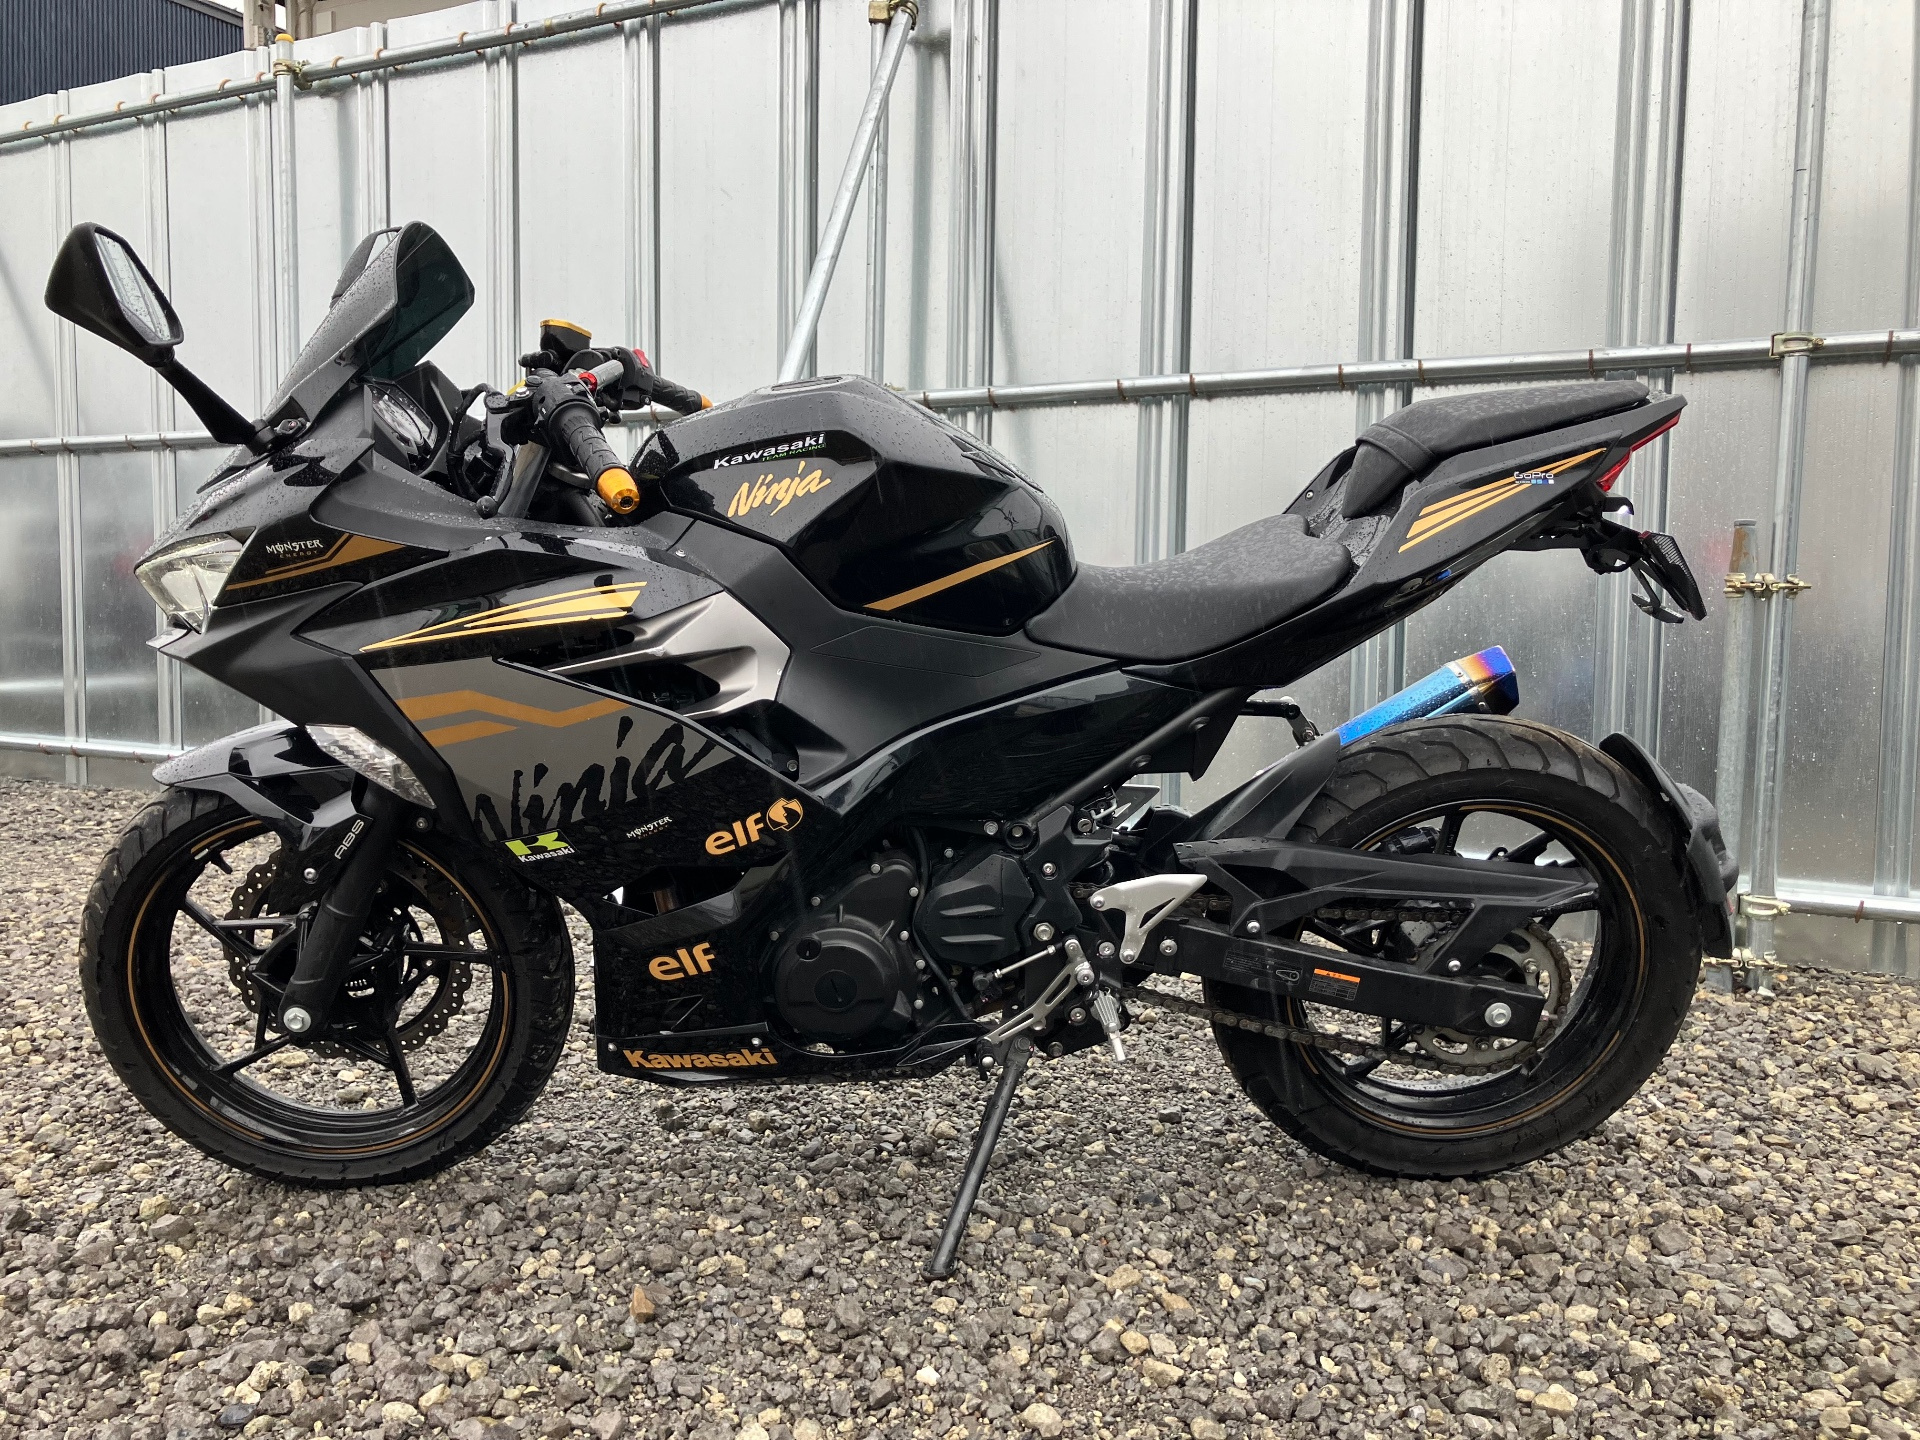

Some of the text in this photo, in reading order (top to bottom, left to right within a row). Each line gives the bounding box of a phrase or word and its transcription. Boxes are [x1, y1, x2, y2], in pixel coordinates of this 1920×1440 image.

[713, 433, 825, 470] Kawasaki
[762, 452, 787, 462] TEAM
[727, 460, 832, 518] Ninja
[1513, 471, 1554, 479] GoPro
[265, 539, 324, 554] MONSTER
[472, 716, 718, 842] Ninja
[334, 819, 365, 860] ABS
[705, 811, 764, 856] elf
[517, 846, 576, 863] Kawasaki
[648, 942, 716, 981] elf
[622, 1047, 778, 1069] Kawasaki
